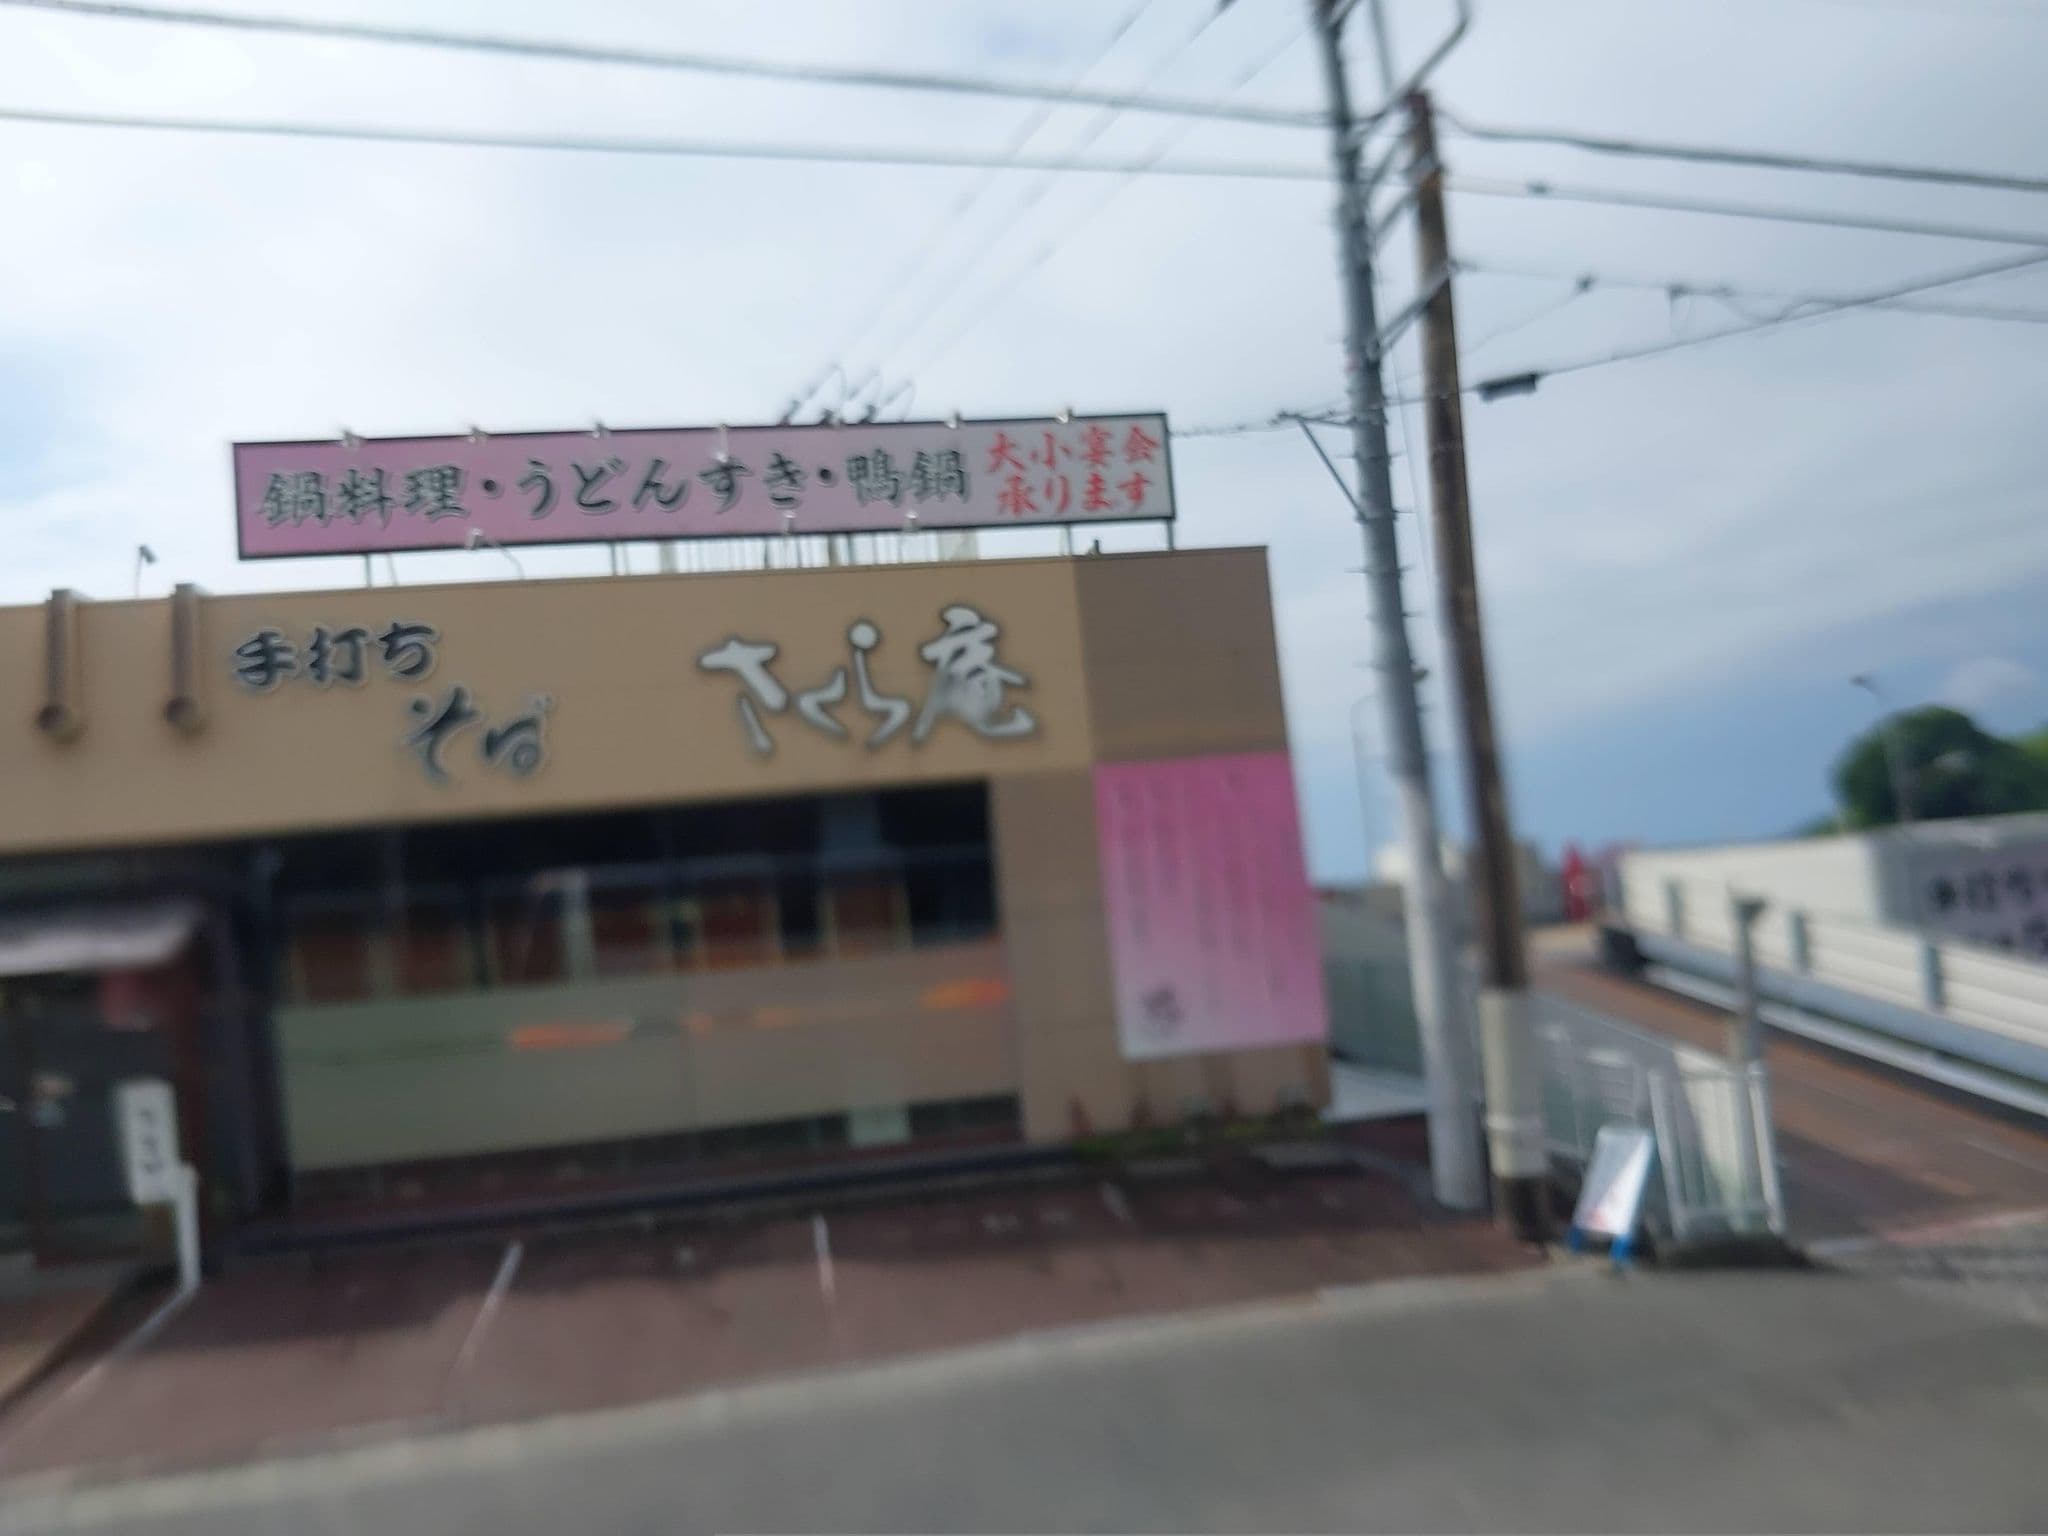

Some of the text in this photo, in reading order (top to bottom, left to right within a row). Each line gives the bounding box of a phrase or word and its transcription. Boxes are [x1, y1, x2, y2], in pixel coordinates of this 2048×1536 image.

[985, 424, 1159, 474] 大小宴会
[998, 471, 1153, 517] 承ります
[235, 621, 436, 688] 手打ち
[700, 605, 1036, 752] さくら庵
[408, 686, 554, 783] そば
